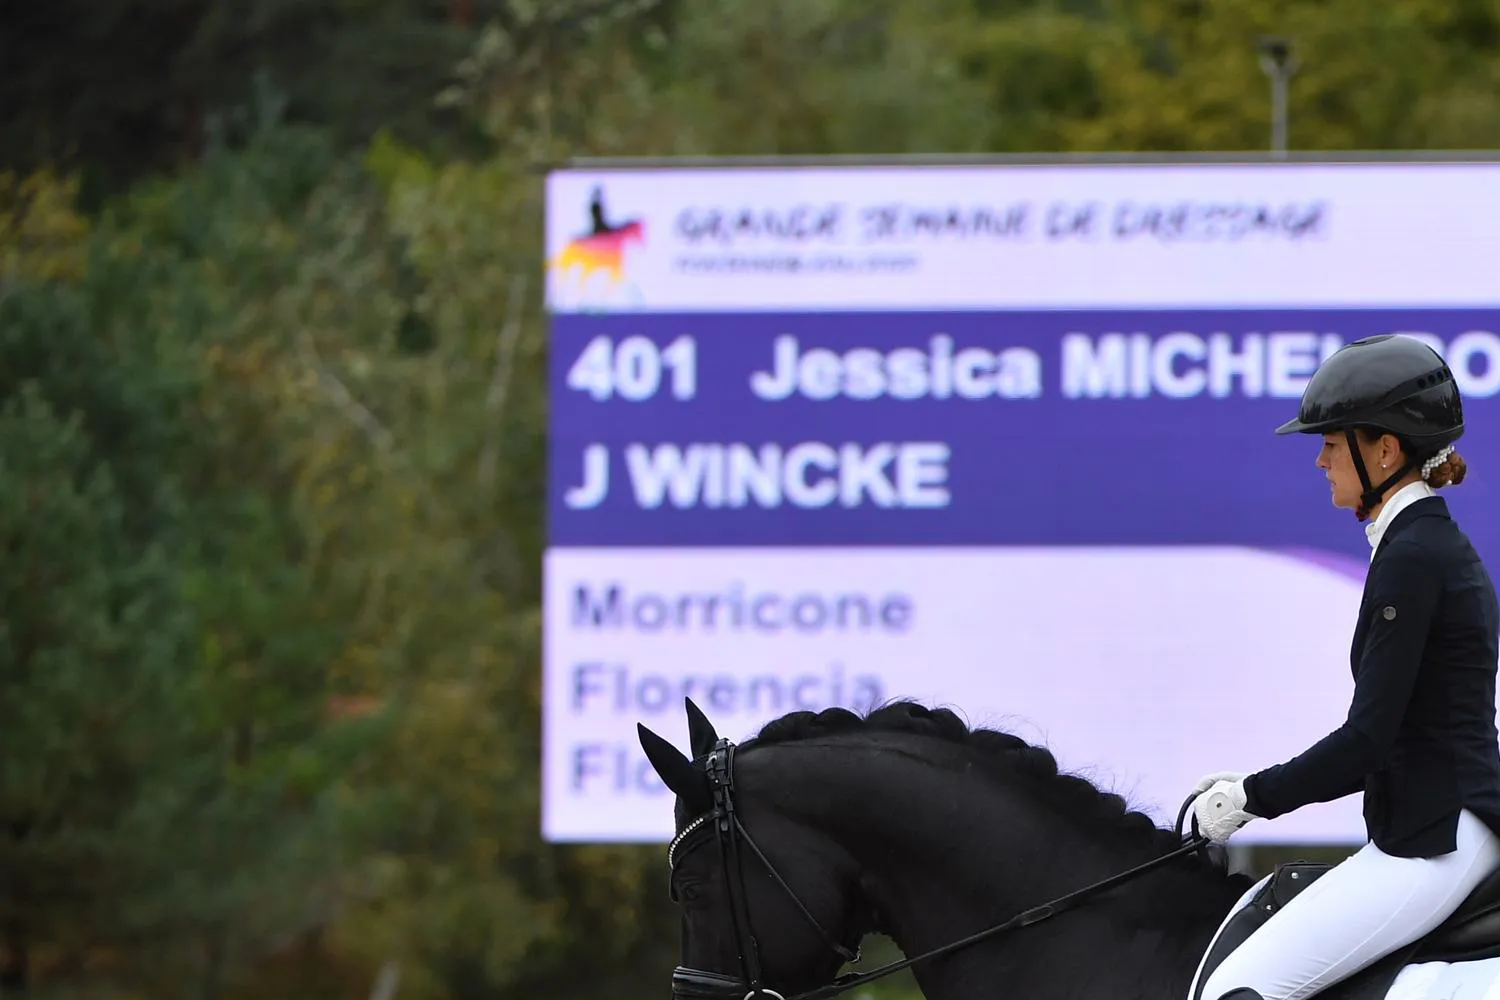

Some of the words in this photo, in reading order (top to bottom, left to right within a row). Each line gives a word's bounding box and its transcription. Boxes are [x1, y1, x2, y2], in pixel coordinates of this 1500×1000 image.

[673, 202, 841, 246] GRANDE
[567, 335, 697, 400] 401
[750, 335, 1042, 400] Jessica
[566, 444, 609, 509] J
[625, 443, 950, 509] WINCKE
[570, 584, 914, 634] Morricone
[570, 660, 886, 712] Florencia
[571, 742, 668, 796] Flo
